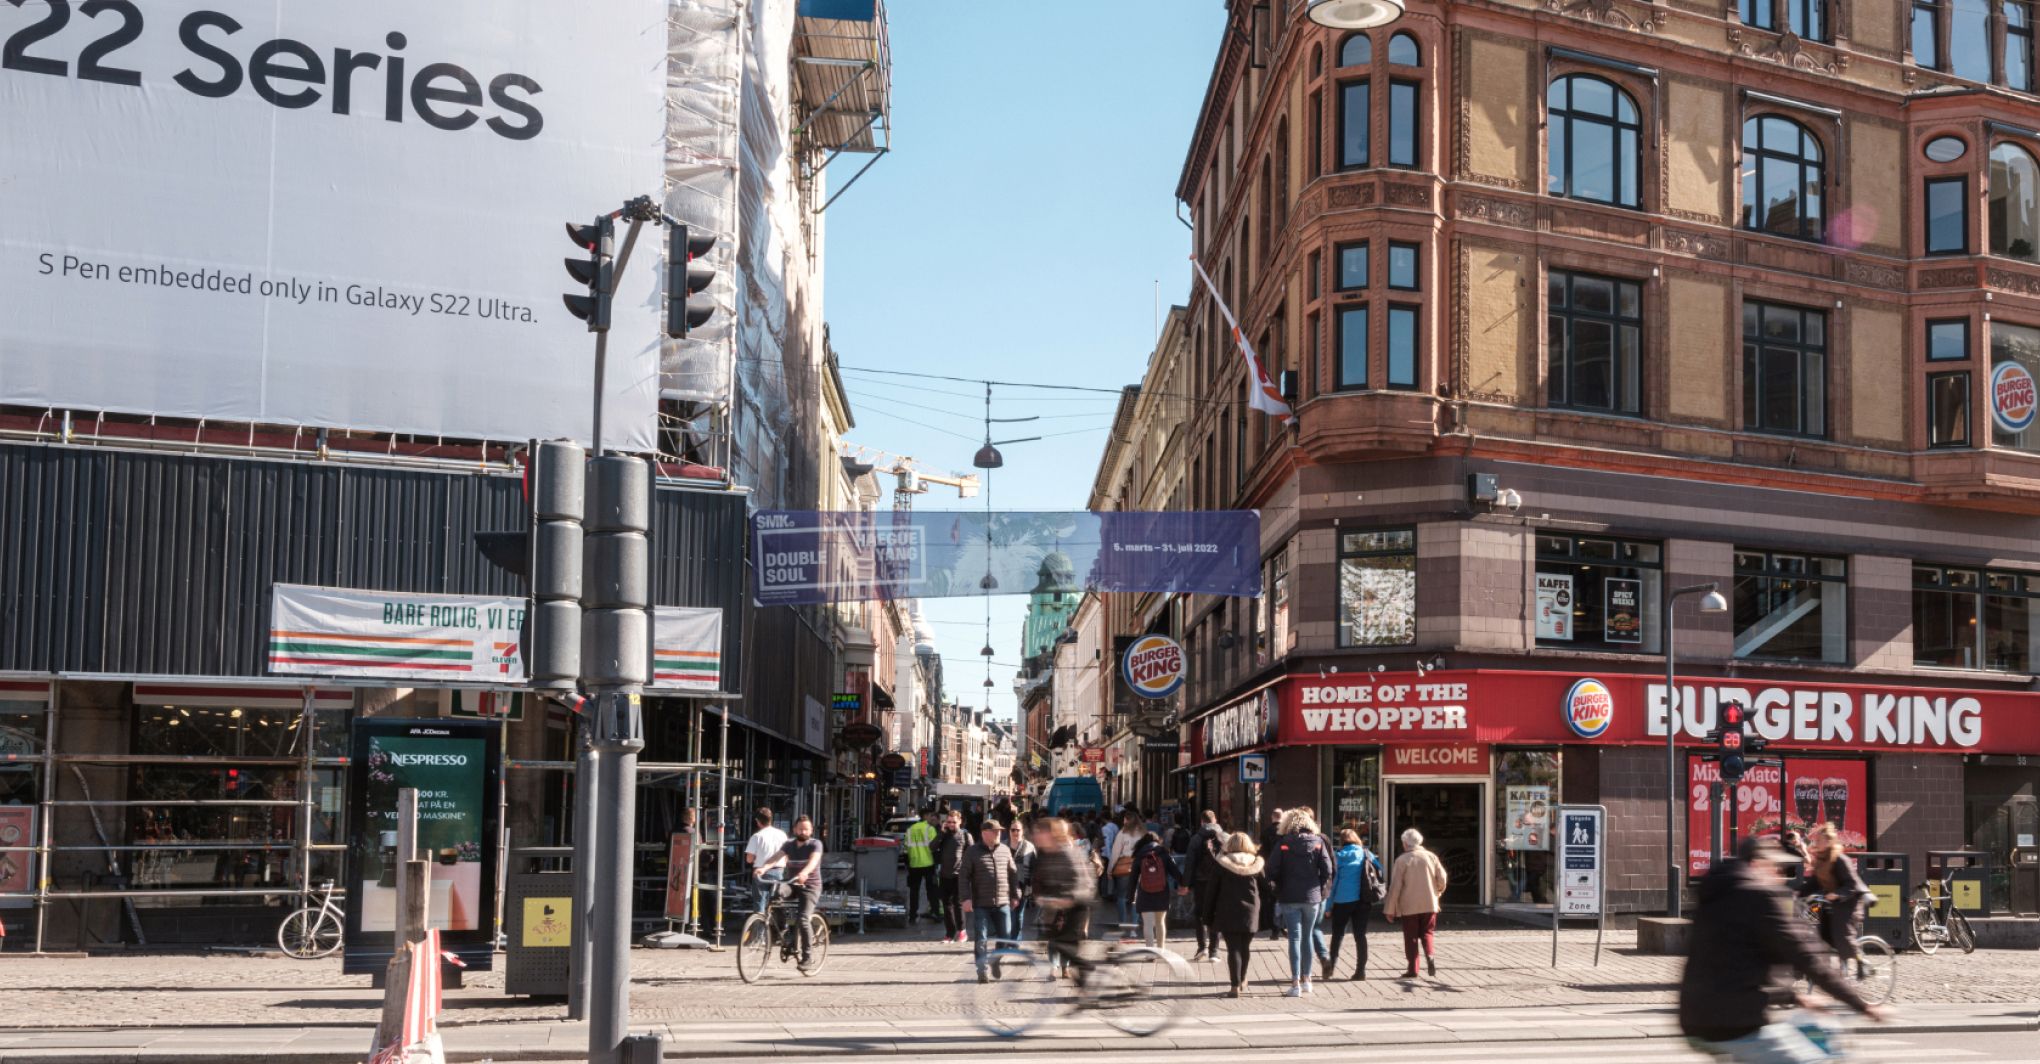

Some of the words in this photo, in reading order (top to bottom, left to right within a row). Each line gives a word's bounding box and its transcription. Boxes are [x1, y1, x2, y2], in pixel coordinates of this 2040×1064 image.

[2, 0, 144, 87] 22
[173, 10, 543, 140] Series
[38, 253, 54, 275] S
[63, 255, 110, 280] Pen
[118, 264, 252, 294] embedded
[260, 277, 311, 304] only
[318, 281, 338, 303] in
[346, 284, 425, 316] Galaxy
[430, 293, 471, 316] S22
[478, 297, 538, 323] Ultra.
[1997, 378, 2032, 395] BURGER
[1999, 389, 2034, 413] KING
[858, 532, 918, 547] HAEGUE
[1113, 543, 1124, 551] 5.
[1125, 544, 1153, 552] marts
[1178, 544, 1193, 554] juli
[1194, 544, 1218, 553] 2022
[766, 551, 827, 567] DOUBLE
[876, 548, 918, 561] YANG
[766, 567, 807, 583] SOUL
[1539, 579, 1569, 590] KAFFE
[383, 602, 426, 626] BARE
[430, 605, 482, 631] ROLIG,
[487, 608, 503, 630] VI
[1130, 646, 1180, 668] BURGER
[1133, 656, 1181, 685] KING
[1302, 686, 1373, 704] HOME
[1377, 685, 1411, 702] OF
[1416, 683, 1468, 701] THE
[1573, 693, 1609, 708] BURGER
[1302, 706, 1468, 731] WHOPPER
[1573, 703, 1609, 722] KING
[1647, 684, 1854, 742] BURGER
[1863, 693, 1982, 747] KING
[388, 751, 467, 767] NESPRESSO
[1394, 747, 1478, 765] WELCOME
[1693, 764, 1722, 782] Mix
[1510, 791, 1546, 800] KAFFE
[1693, 784, 1709, 812] 2
[443, 801, 456, 809] EN
[1568, 902, 1591, 910] Zone
